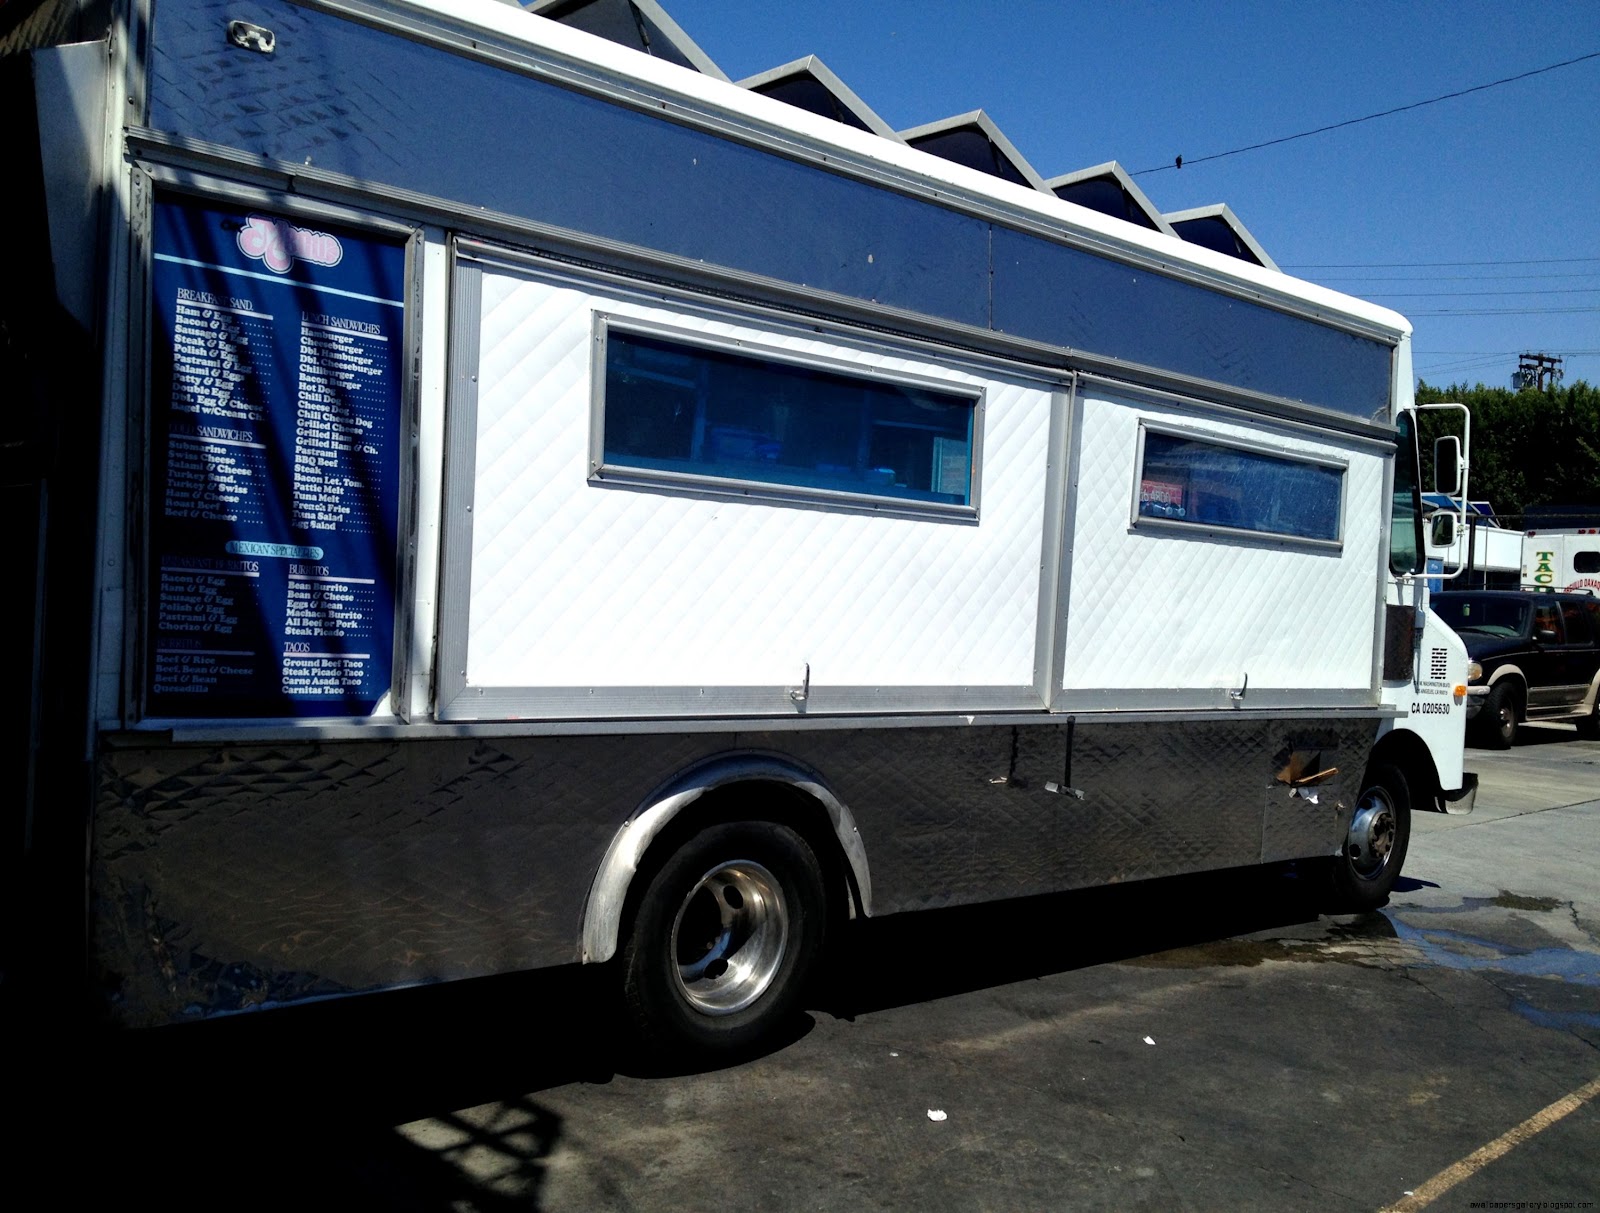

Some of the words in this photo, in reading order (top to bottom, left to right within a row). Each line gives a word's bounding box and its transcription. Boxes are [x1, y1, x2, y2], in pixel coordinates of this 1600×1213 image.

[229, 297, 253, 311] SAND.
[176, 304, 200, 317] Ham
[202, 309, 212, 318] &
[213, 311, 232, 324] Egg
[176, 314, 208, 327] Bacon
[209, 320, 219, 329] &
[221, 322, 240, 334] Egg
[302, 310, 329, 325] LUNCH
[330, 316, 381, 335] SANDWICHES
[174, 324, 217, 339] Sausage
[218, 331, 228, 340] &
[230, 333, 248, 346] Egg
[301, 326, 354, 344] Hamburger
[174, 334, 205, 346] Steak
[206, 340, 217, 348] &
[218, 341, 237, 353] Egg
[300, 336, 364, 354] Cheeseburger
[173, 343, 207, 356] Polish
[208, 349, 219, 357] &
[220, 350, 239, 363] Egg
[300, 345, 320, 356] Dbl.
[321, 349, 373, 365] Hamburger
[173, 353, 220, 368] Pastrami
[222, 360, 232, 369] &
[233, 362, 252, 374] Egg
[173, 363, 209, 376] Salami
[210, 368, 221, 377] &
[299, 354, 320, 365] Dbl.
[320, 358, 383, 376] Cheeseburger
[299, 363, 355, 380] Chiliburger
[172, 372, 202, 385] Patty
[203, 377, 213, 386] &
[214, 378, 234, 390] Egg
[298, 381, 317, 392] Hot
[317, 384, 336, 396] Dog
[299, 372, 328, 384] Bacon
[329, 377, 362, 390] Burger
[172, 382, 210, 395] Double
[211, 387, 231, 400] Egg
[298, 391, 322, 402] Chili
[323, 394, 341, 406] Dog
[171, 392, 194, 402] Dbl.
[196, 395, 217, 407] Egg
[217, 398, 227, 407] &
[229, 399, 263, 411] Cheese
[297, 400, 330, 412] Cheese
[331, 405, 350, 416] Dog
[171, 401, 200, 414] Bagel
[201, 406, 247, 419] w/Cream
[296, 418, 331, 430] Grilled
[331, 423, 363, 435] Cheese
[297, 409, 321, 420] Chili
[322, 413, 354, 424] Cheese
[355, 417, 373, 429] Dog
[196, 425, 253, 442] SANDWICHES
[296, 427, 331, 439] Grilled
[331, 432, 352, 442] Ham
[168, 440, 227, 454] Submarine
[295, 436, 330, 448] Grilled
[331, 440, 352, 451] Ham
[353, 444, 362, 452] &
[362, 445, 379, 455] Ch.
[295, 445, 337, 458] Pastrami
[168, 449, 198, 460] Swiss
[200, 453, 236, 465] Cheese
[294, 454, 316, 466] BBQ
[317, 457, 338, 468] Beef
[168, 459, 203, 470] Salami
[206, 463, 216, 472] &
[216, 464, 252, 476] Cheese
[294, 464, 322, 475] Steak
[167, 469, 205, 481] Turkey
[207, 473, 237, 484] Sand.
[293, 472, 323, 484] Bacon
[324, 476, 342, 486] Let.
[343, 478, 365, 488] Tom.
[167, 478, 205, 491] Turkey
[207, 483, 217, 491] &
[218, 483, 248, 494] Swiss
[293, 482, 322, 493] Pattie
[323, 485, 345, 495] Melt
[165, 488, 191, 498] Ham
[192, 490, 202, 499] &
[204, 493, 240, 503] Cheese
[292, 491, 317, 501] Tuna
[318, 494, 340, 504] Melt
[165, 497, 195, 508] Roast
[197, 500, 220, 510] Beef
[292, 501, 326, 512] French
[326, 504, 350, 514] Fries
[165, 507, 188, 518] Beef
[190, 509, 200, 518] &
[201, 511, 238, 522] Cheese
[291, 510, 316, 520] Tuna
[317, 512, 343, 522] Salad
[309, 520, 336, 531] Salad
[230, 541, 269, 555] MEXICAN
[289, 564, 329, 576] BURRITOS
[287, 581, 311, 590] Bean
[313, 583, 348, 592] Burrito
[287, 590, 311, 599] Bean
[312, 591, 321, 599] &
[322, 593, 354, 602] Cheese
[287, 599, 309, 609] Eggs
[309, 600, 319, 609] &
[320, 601, 343, 610] Bean
[286, 608, 326, 618] Machaca
[328, 610, 362, 620] Burrito
[285, 617, 301, 626] All
[302, 618, 323, 627] Beef
[324, 620, 335, 628] or
[336, 620, 358, 629] Pork
[284, 627, 312, 636] Steak
[313, 628, 345, 637] Picado
[284, 642, 311, 652] TACOS
[283, 658, 320, 667] Ground
[321, 659, 342, 668] Beef
[342, 660, 364, 669] Taco
[282, 667, 310, 676] Steak
[311, 668, 343, 677] Picado
[343, 669, 364, 677] Taco
[282, 676, 311, 685] Carne
[311, 676, 340, 686] Asada
[341, 677, 362, 686] Taco
[281, 686, 322, 695] Carnitas
[323, 686, 345, 695] Taco
[1411, 702, 1420, 714] CA
[1422, 702, 1450, 714] 0205630
